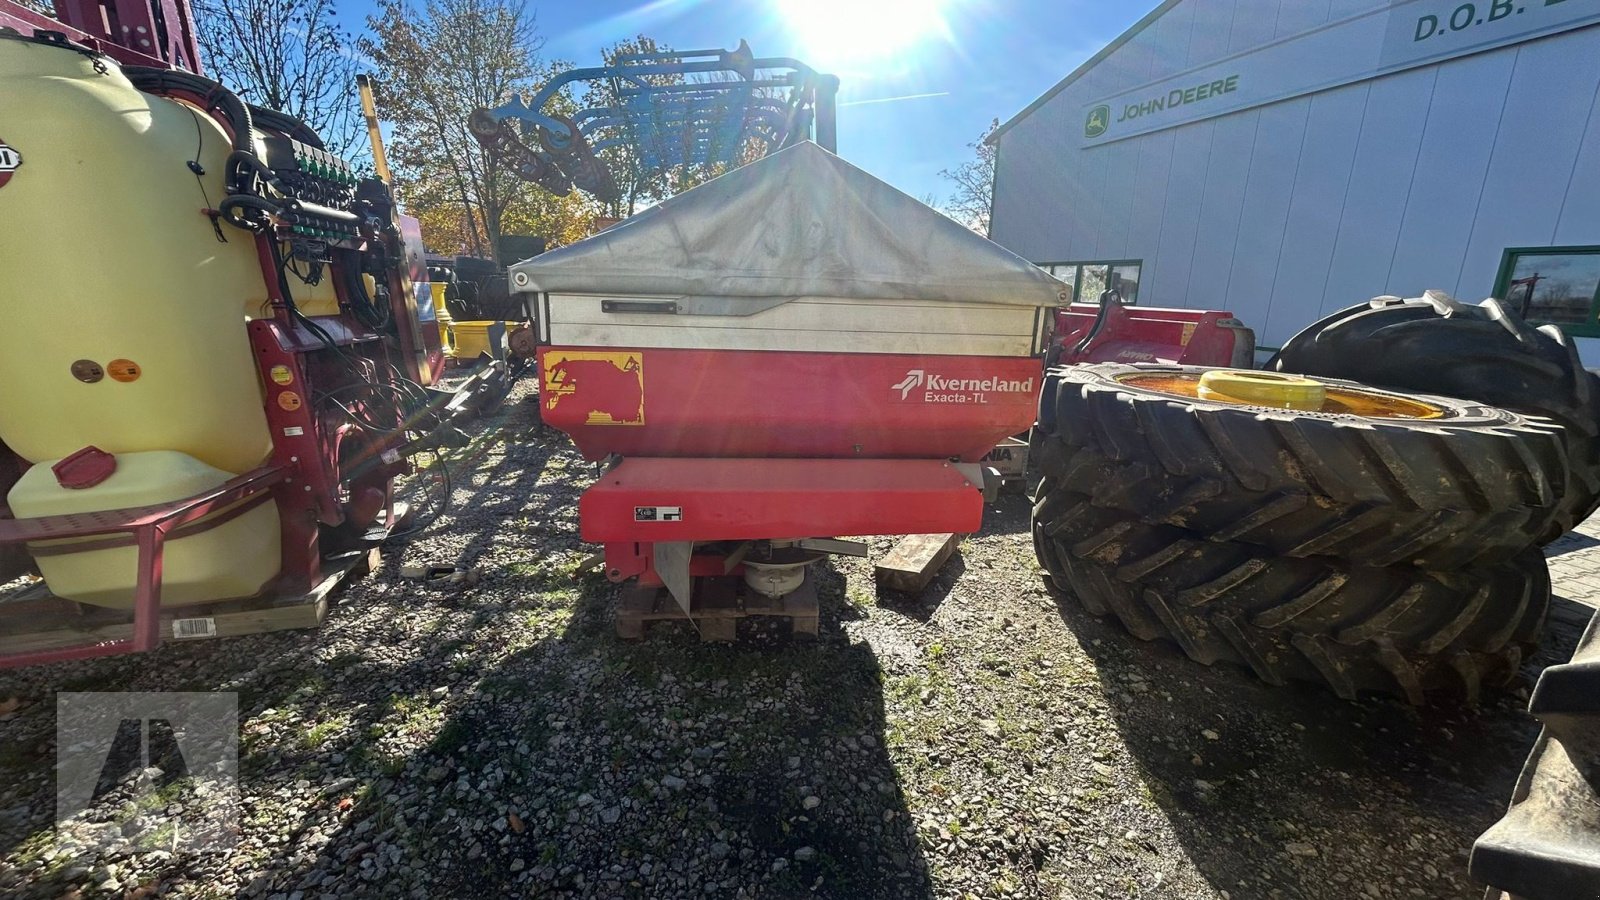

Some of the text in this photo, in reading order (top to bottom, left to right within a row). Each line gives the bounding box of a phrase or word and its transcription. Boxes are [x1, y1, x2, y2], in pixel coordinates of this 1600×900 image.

[1414, 0, 1525, 42] D.O.B.
[1117, 74, 1240, 123] JOHN DEERE
[924, 391, 988, 403] Exacta-TL
[927, 374, 1034, 392] Kverneland
